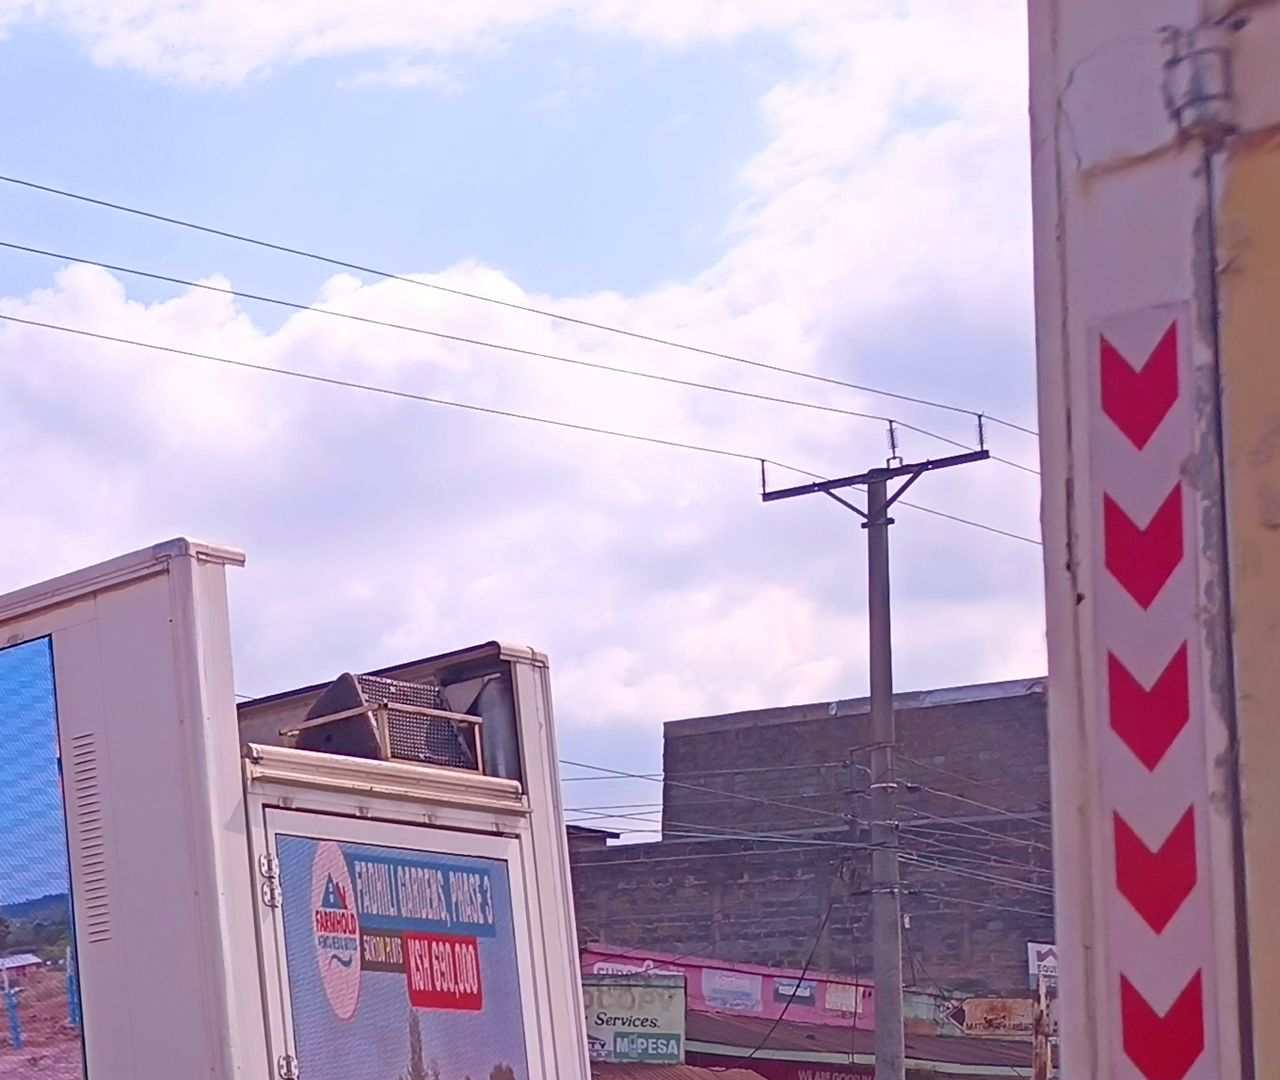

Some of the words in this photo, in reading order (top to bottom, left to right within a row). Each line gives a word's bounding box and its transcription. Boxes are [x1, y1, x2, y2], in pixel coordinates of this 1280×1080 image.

[354, 860, 398, 917] FADHILI
[449, 870, 485, 925] PHASE
[483, 874, 494, 925] 3
[315, 909, 357, 935] FARMHOLD
[407, 938, 433, 992] KSH
[431, 940, 479, 999] 690,000
[594, 1011, 661, 1028] Services.
